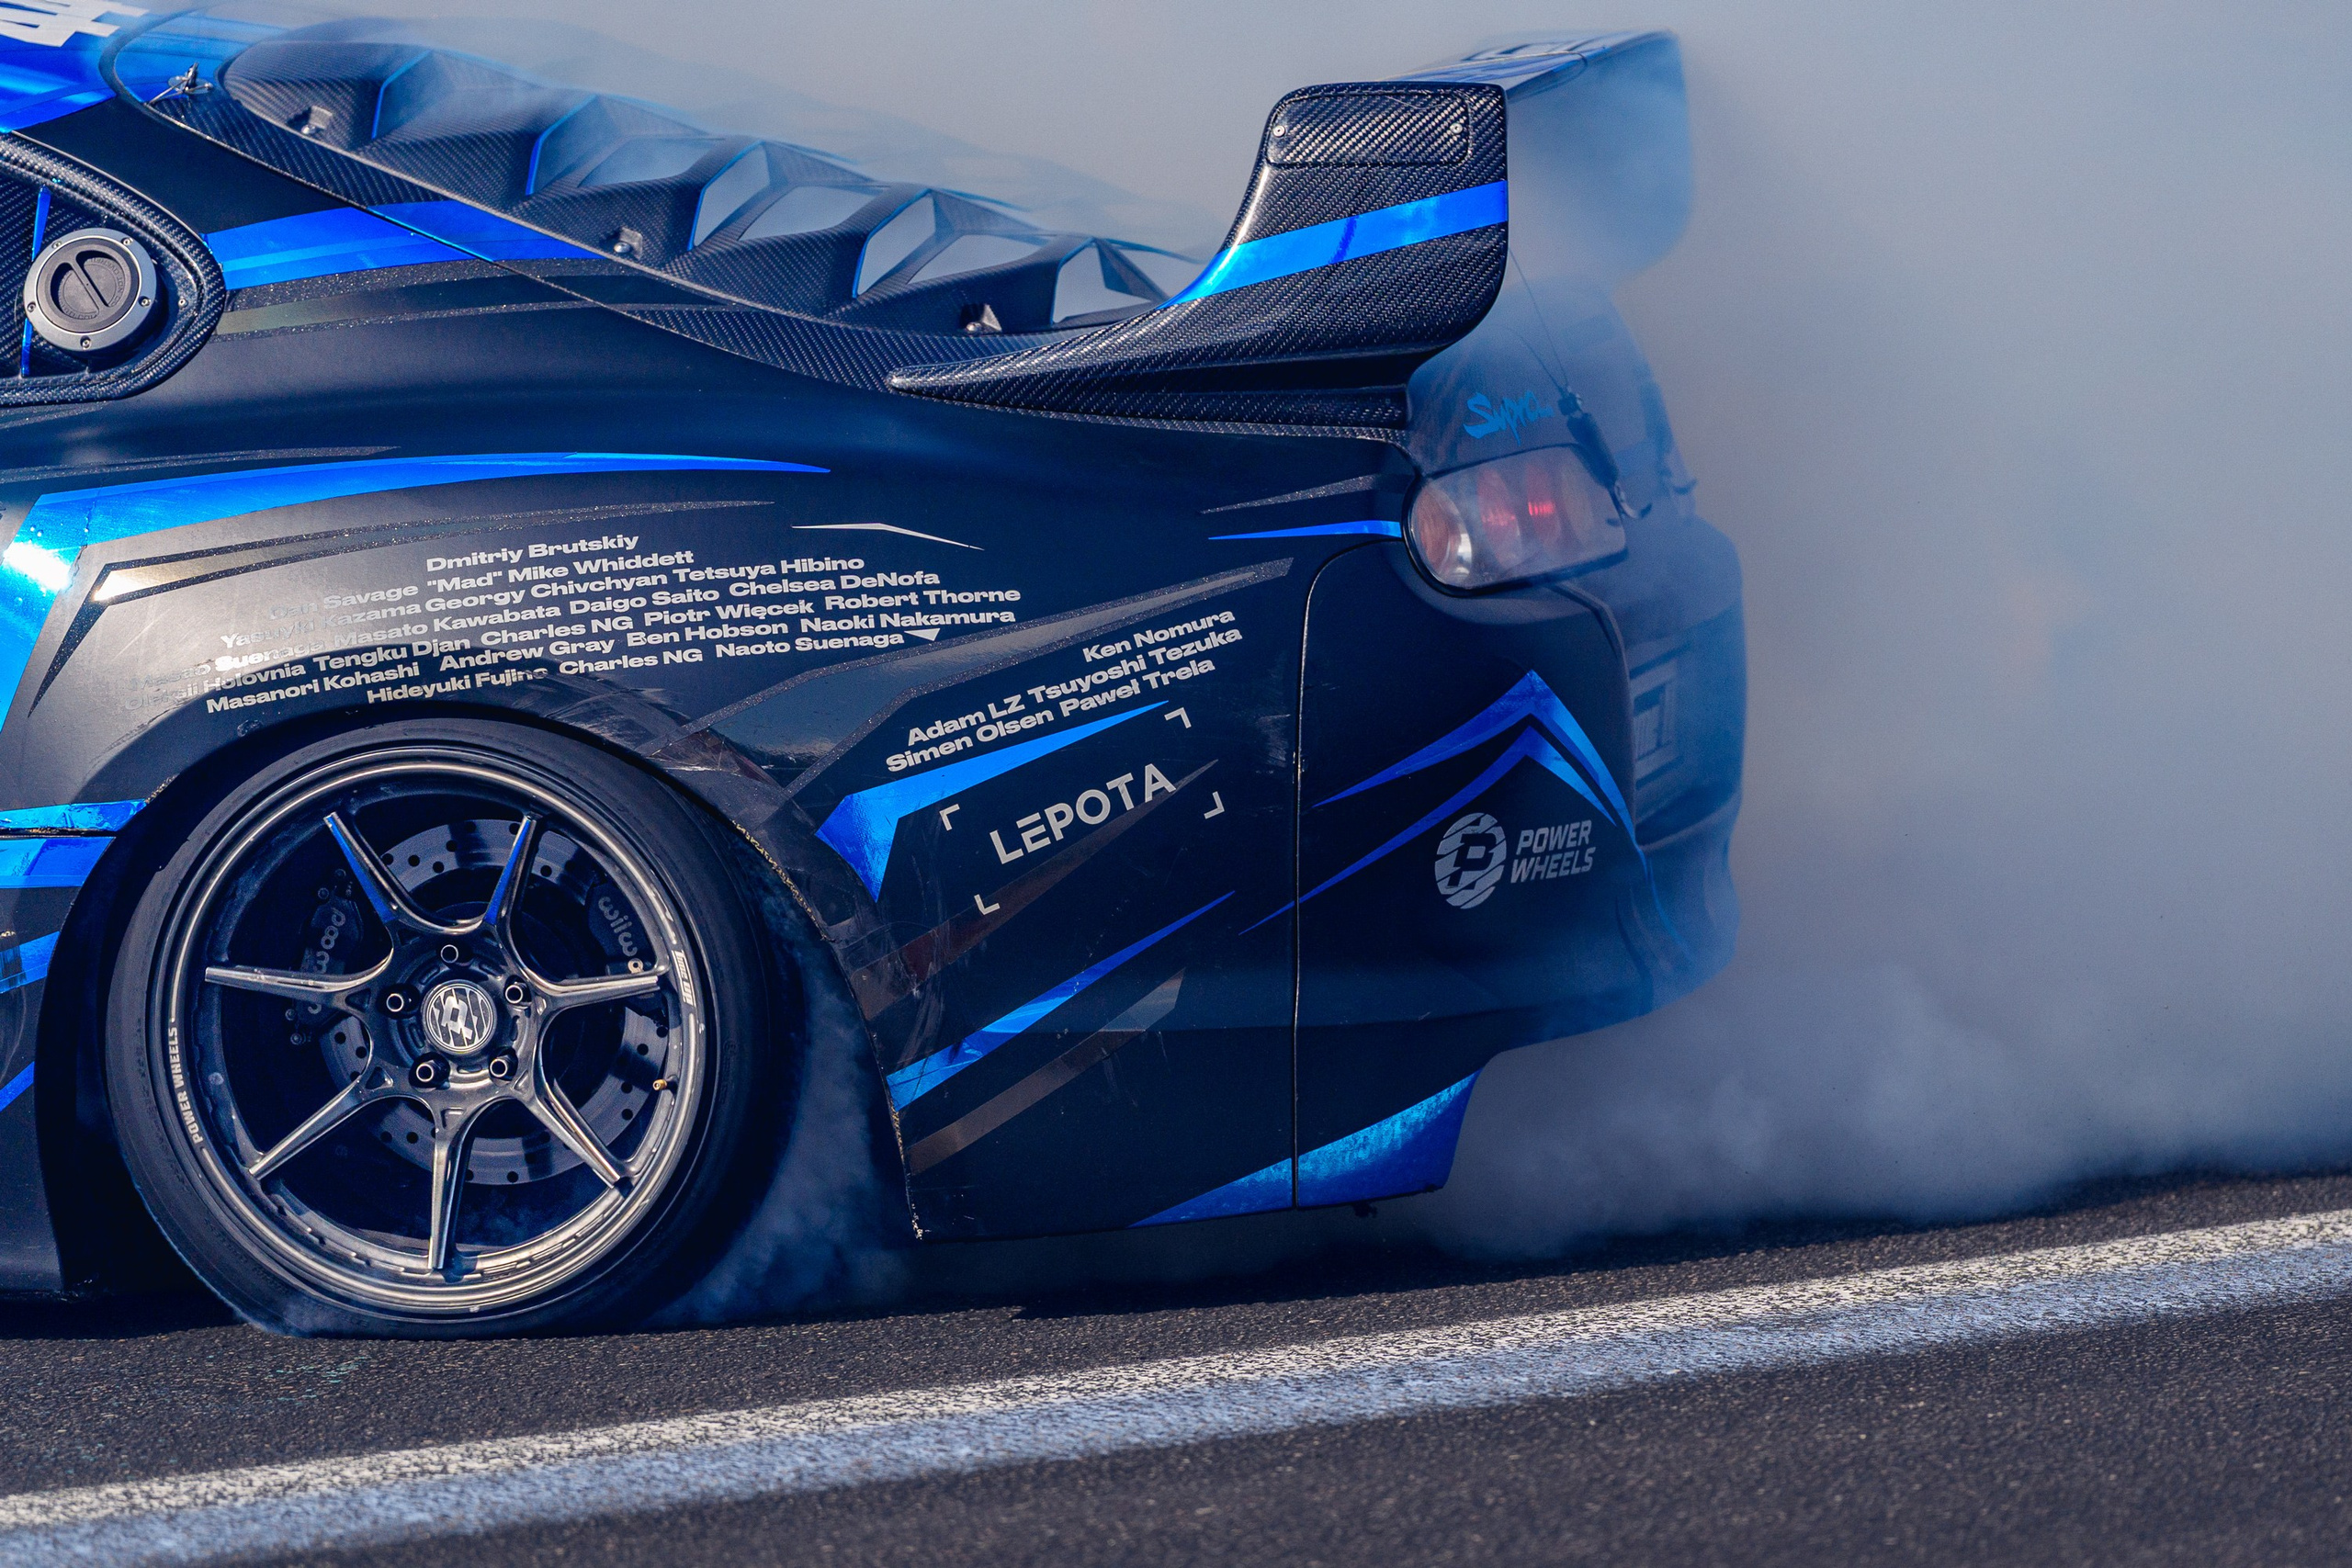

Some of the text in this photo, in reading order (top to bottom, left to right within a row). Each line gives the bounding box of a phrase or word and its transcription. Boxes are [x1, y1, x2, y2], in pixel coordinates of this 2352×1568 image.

[322, 585, 419, 609] Savage
[427, 571, 503, 592] "Mad"
[508, 566, 569, 582] Mike
[573, 551, 694, 574] Whiddett
[322, 603, 421, 628] Kazama
[425, 590, 526, 611] Georgy
[531, 574, 667, 597] Chivchyan
[673, 565, 776, 582] Tetsuya
[781, 557, 865, 573] Hibino
[427, 535, 639, 571] Dmitriy Brutskiy
[203, 662, 307, 694] Holovnia
[312, 646, 407, 671] Tengku
[413, 639, 470, 657] Djan
[481, 625, 586, 645] Charles
[591, 616, 633, 633] NG
[644, 609, 710, 626] Piotr
[825, 592, 919, 610] Robert
[923, 590, 1021, 604] Thorne
[207, 612, 1015, 713] Masanori Kohashi Andrew Gray Ben Hobson Naoki Nakamura
[215, 641, 324, 671] Suenaga
[334, 623, 428, 648] Masato
[434, 606, 561, 631] Kawabata
[570, 597, 647, 615] Daigo
[652, 589, 719, 605] Saito
[729, 579, 836, 596] Chelsea
[841, 570, 940, 589] DeNofa
[1082, 611, 1235, 662] Ken Nomura
[367, 675, 471, 704] Hideyuki
[560, 655, 658, 674] Charles
[663, 649, 703, 664] NG
[716, 641, 790, 658] Naoto
[795, 634, 904, 651] Suenaga
[909, 629, 1242, 746] Adam LZ Tsuyoshi Tezuka
[886, 737, 973, 772] Simen
[977, 710, 1054, 741] Olsen
[1142, 660, 1216, 689] Trela
[989, 763, 1176, 864] LEPOTA
[1516, 820, 1592, 855] POWER
[1510, 847, 1597, 884] WHEELS
[168, 1027, 203, 1144] POWER WHEELS
